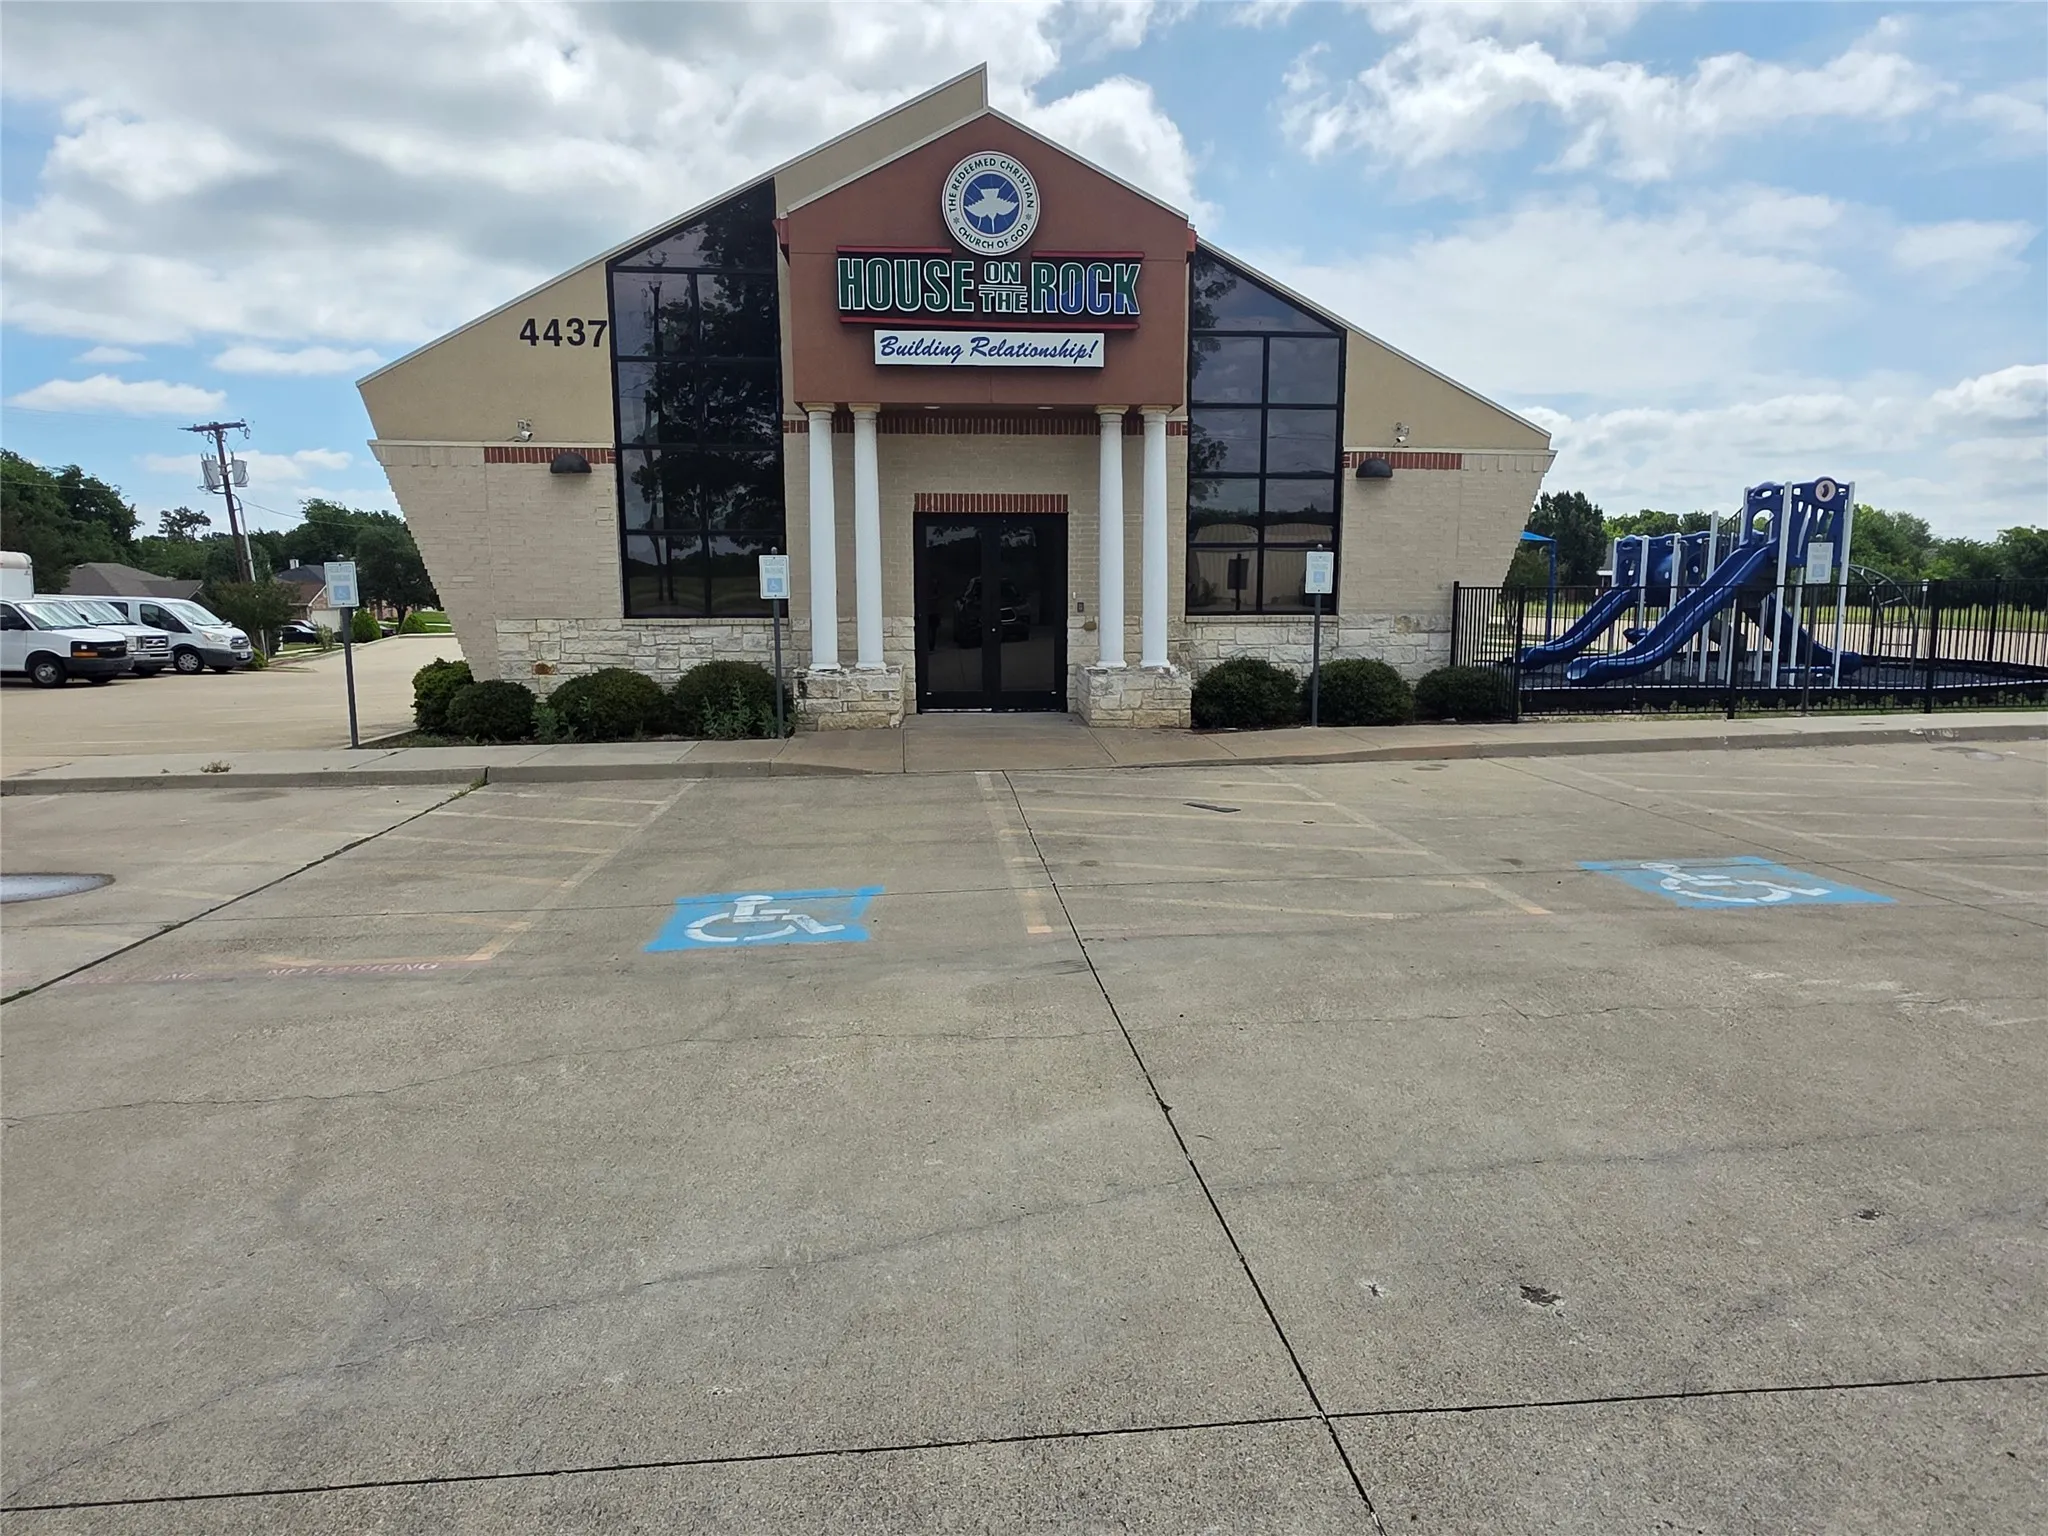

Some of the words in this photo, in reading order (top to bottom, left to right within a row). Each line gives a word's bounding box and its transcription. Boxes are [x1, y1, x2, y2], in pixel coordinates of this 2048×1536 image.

[952, 158, 996, 191] REDEEMED
[999, 160, 1035, 209] CHRISTIAN
[948, 192, 957, 213] THE
[958, 226, 994, 249] CHURCH
[996, 238, 1009, 249] OF
[1010, 223, 1029, 242] GOD
[837, 258, 975, 312] HOUSE
[983, 261, 1021, 284] ON
[979, 290, 1028, 313] THE
[1031, 262, 1141, 315] ROCK
[519, 317, 608, 348] 4437
[880, 335, 963, 364] Building
[969, 336, 1098, 365] Relationship!
